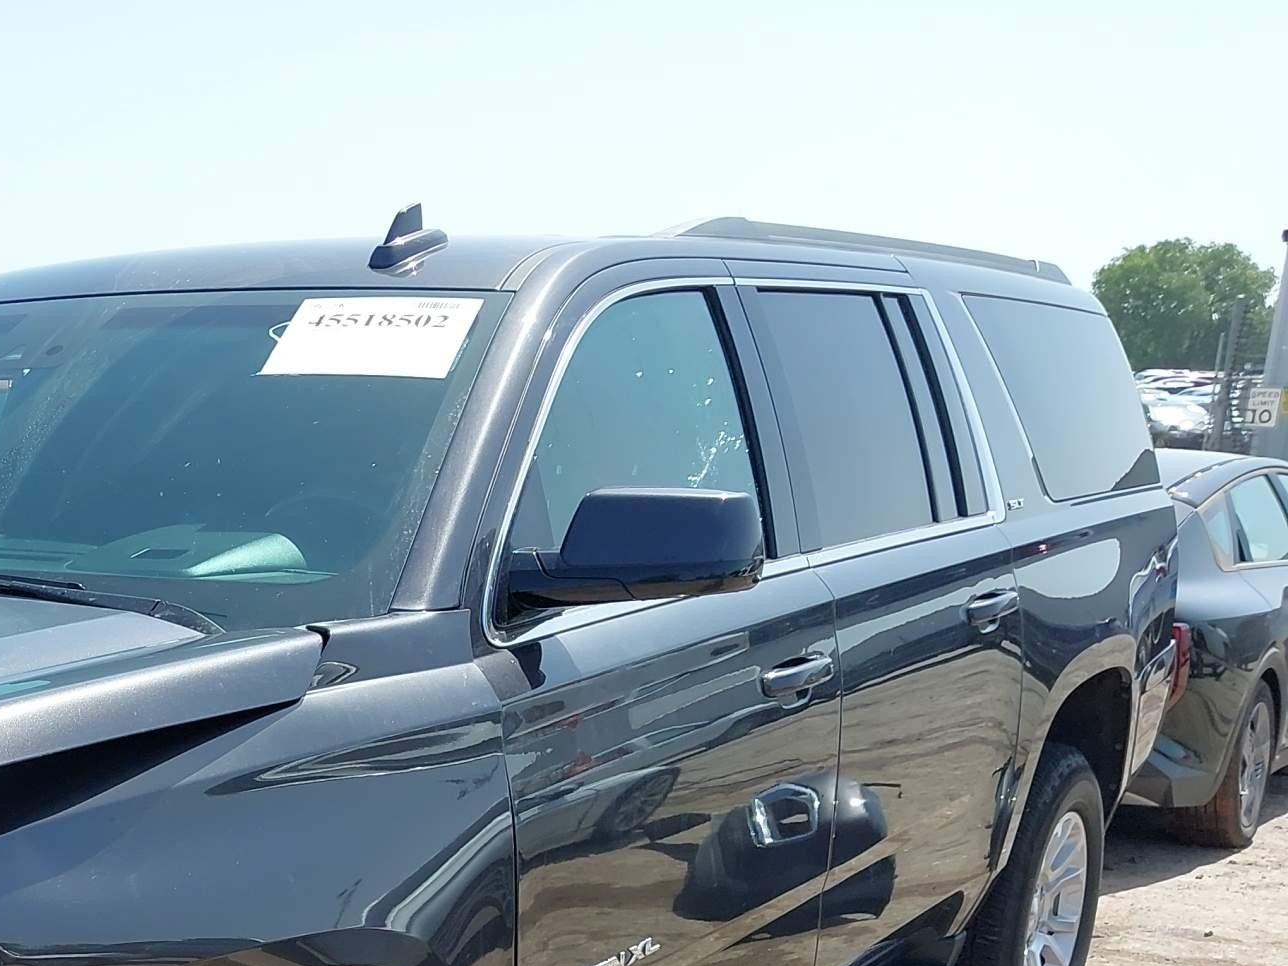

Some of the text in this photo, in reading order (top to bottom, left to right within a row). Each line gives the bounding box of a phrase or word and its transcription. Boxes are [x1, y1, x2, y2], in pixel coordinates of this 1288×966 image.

[307, 312, 449, 328] 45518502
[1251, 390, 1279, 399] SPEED
[1249, 409, 1272, 424] 10
[1007, 498, 1024, 511] SLT
[626, 937, 661, 966] XL
